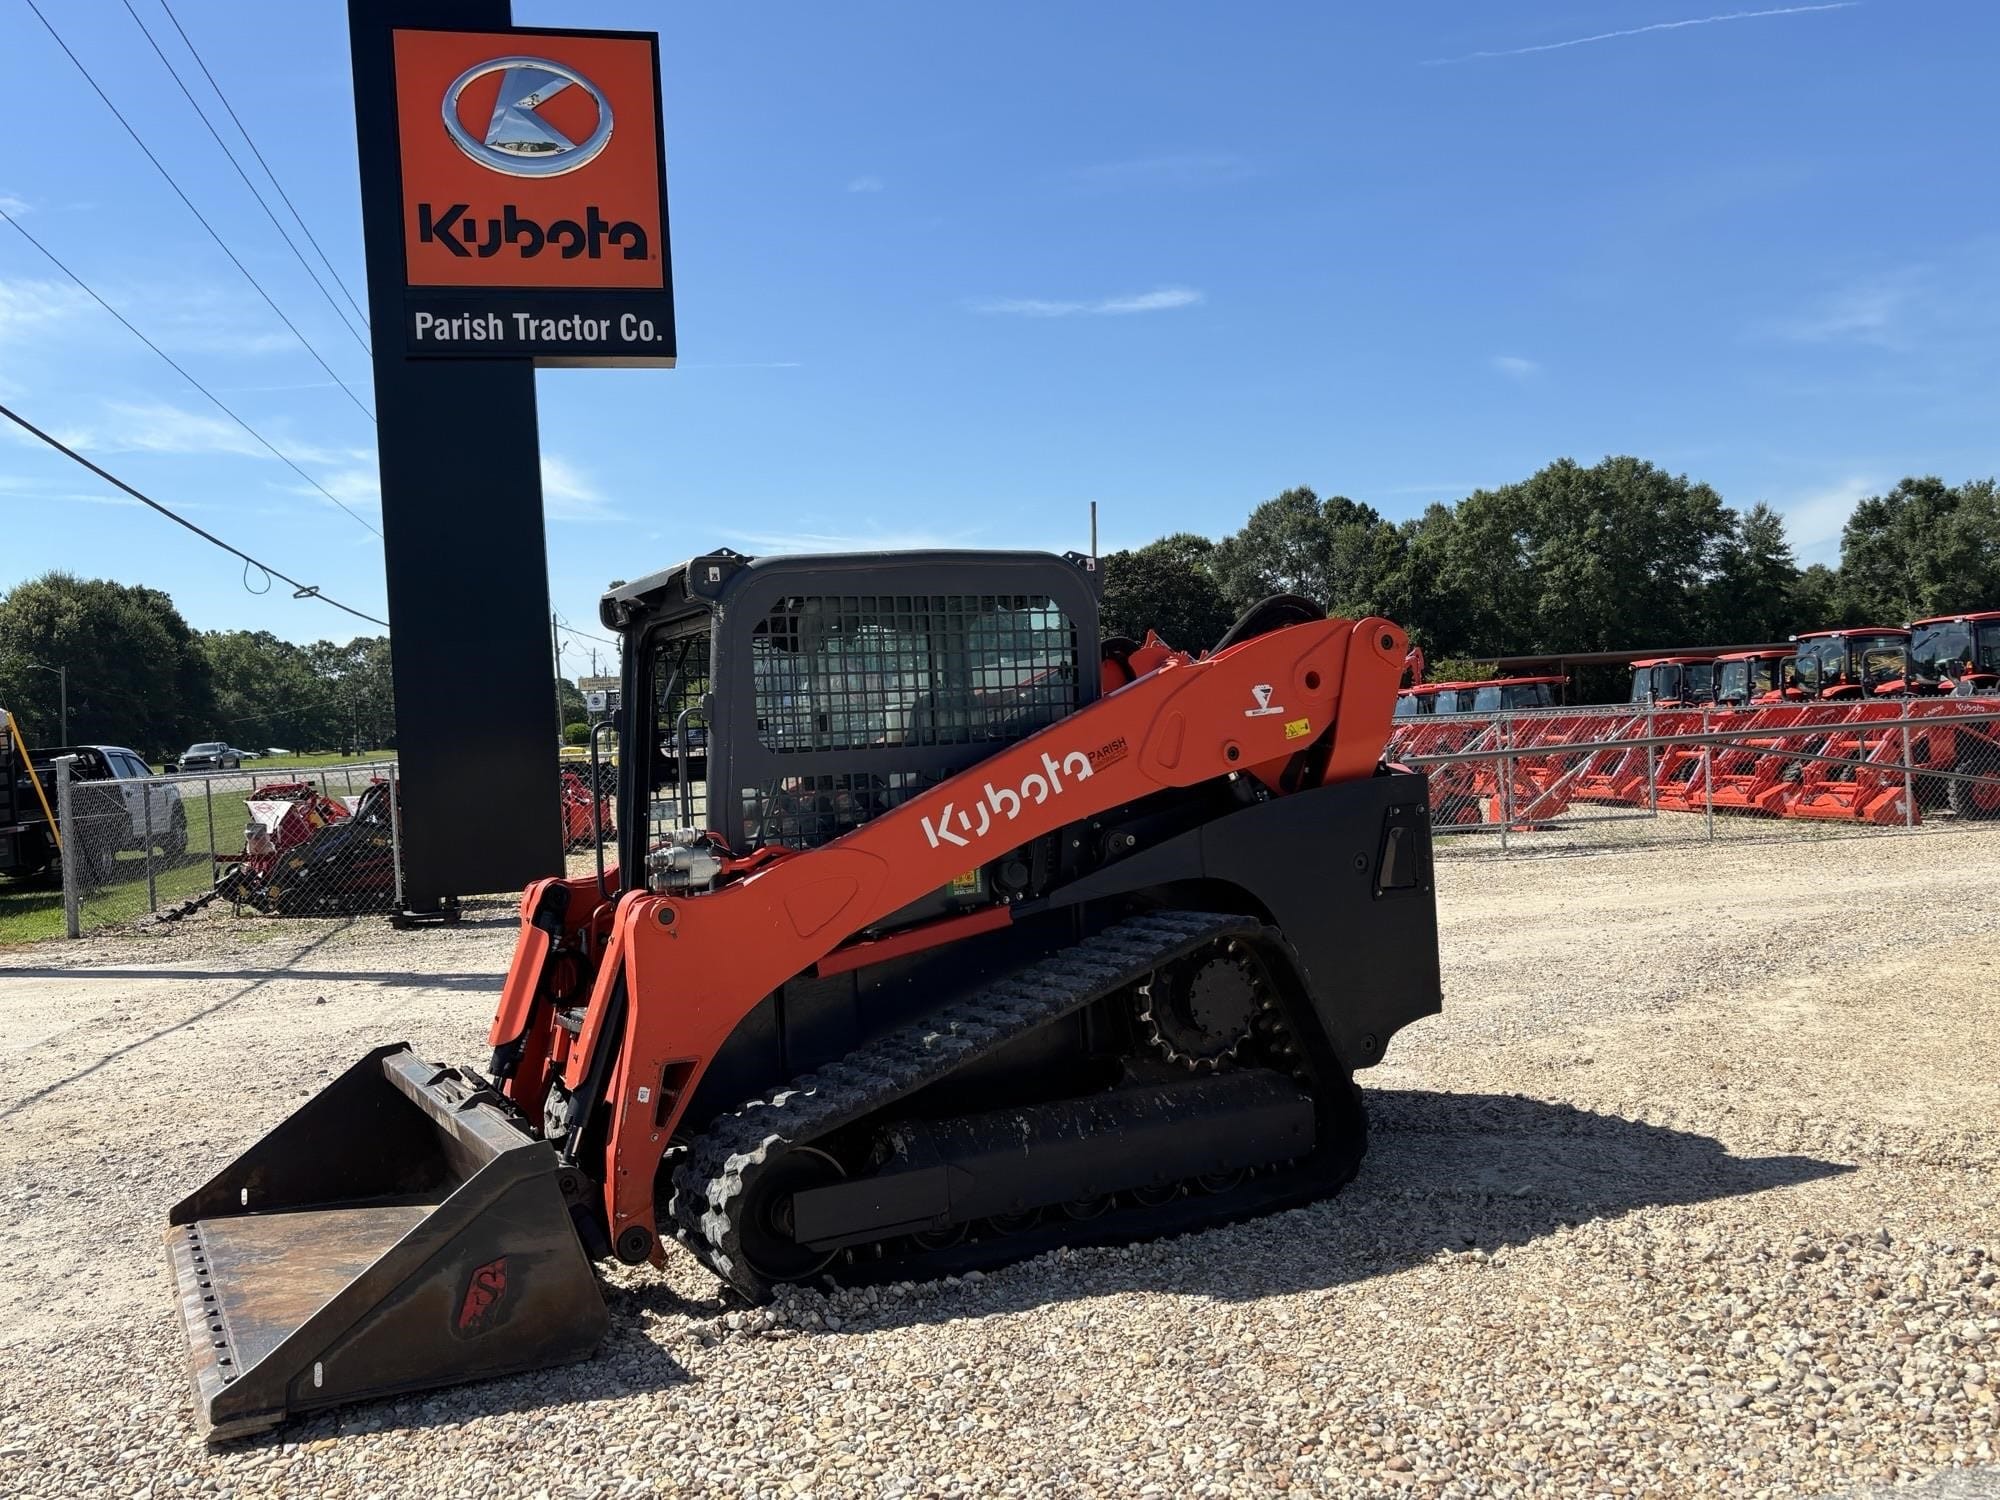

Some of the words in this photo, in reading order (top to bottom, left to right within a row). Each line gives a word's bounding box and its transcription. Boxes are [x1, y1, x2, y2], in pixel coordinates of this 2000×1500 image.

[417, 203, 648, 260] Kubota
[415, 312, 504, 341] Parish
[512, 312, 611, 341] Tractor
[619, 313, 663, 342] Co.
[1955, 702, 1985, 712] Kubota
[1087, 736, 1127, 764] PARISH
[920, 751, 1095, 848] Kubota
